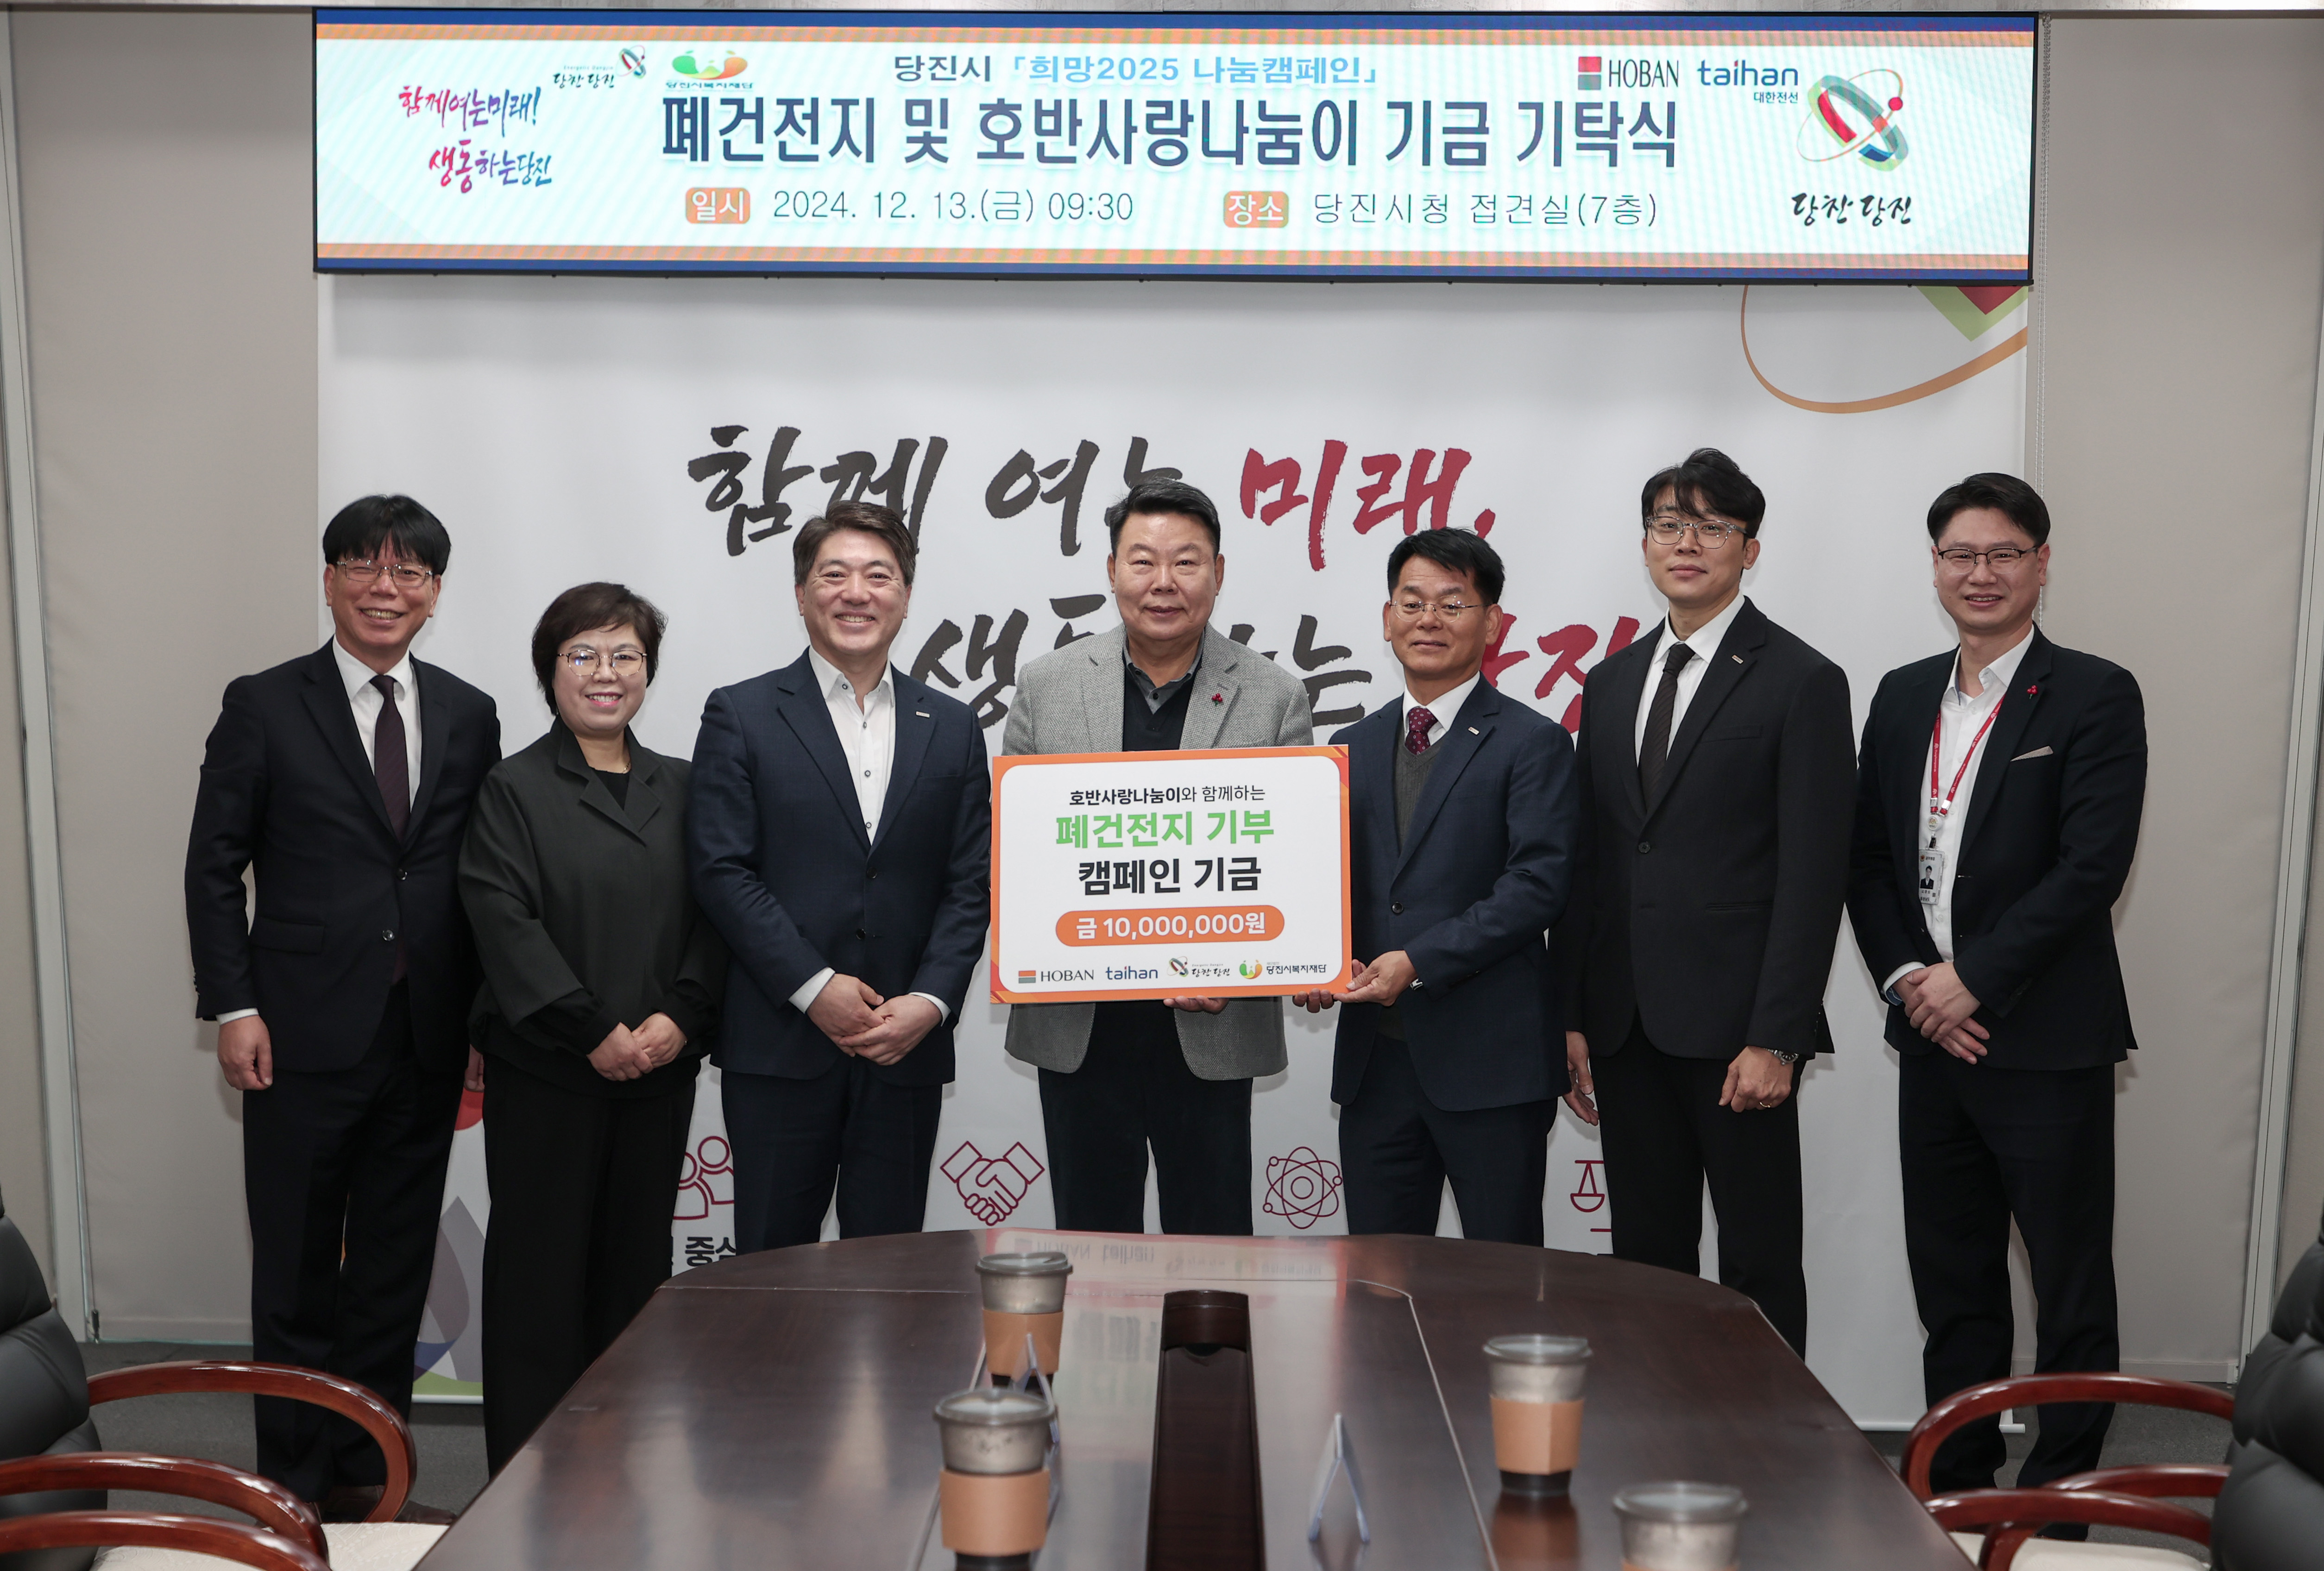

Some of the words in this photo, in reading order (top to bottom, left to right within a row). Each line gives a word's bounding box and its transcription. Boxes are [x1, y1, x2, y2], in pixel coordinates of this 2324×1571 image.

[587, 73, 614, 88] 당진
[895, 55, 990, 82] 당진시
[1608, 59, 1679, 88] HOBAN
[1697, 60, 1798, 86] taihan
[1753, 91, 1798, 104] 대한전선
[663, 96, 875, 163] 폐건전지
[905, 98, 949, 163] 및
[977, 98, 1357, 167] 호반사랑나눔이
[1386, 100, 1490, 167] 기금
[1517, 101, 1676, 168] 기탁식
[692, 190, 744, 222] 일시
[774, 190, 856, 218] 2024.
[875, 191, 915, 219] 12.
[934, 189, 1033, 222] 13.(금)
[1049, 192, 1133, 220] 09:30
[1228, 195, 1284, 226] 장소
[1315, 193, 1448, 224] 당진시청
[1470, 193, 1656, 227] 접견실(7층)
[1791, 193, 1853, 226] 당찬
[1860, 195, 1911, 226] 당진
[687, 425, 948, 557] 함께
[1069, 786, 1197, 806] 호반사랑나눔이와
[1202, 785, 1266, 803] 함께하는
[1056, 811, 1193, 849] 폐건전지
[1207, 810, 1274, 845] 기부
[1078, 858, 1181, 896] 캠페인
[1194, 857, 1262, 892] 기금
[1076, 917, 1097, 940] 금
[1103, 912, 1266, 940] 10,000,000원
[1041, 969, 1094, 982] HOBAN
[1105, 966, 1158, 980] taihan
[1213, 968, 1230, 977] 당진
[1266, 964, 1327, 975] 당진시복지재단
[685, 1236, 737, 1267] 중
